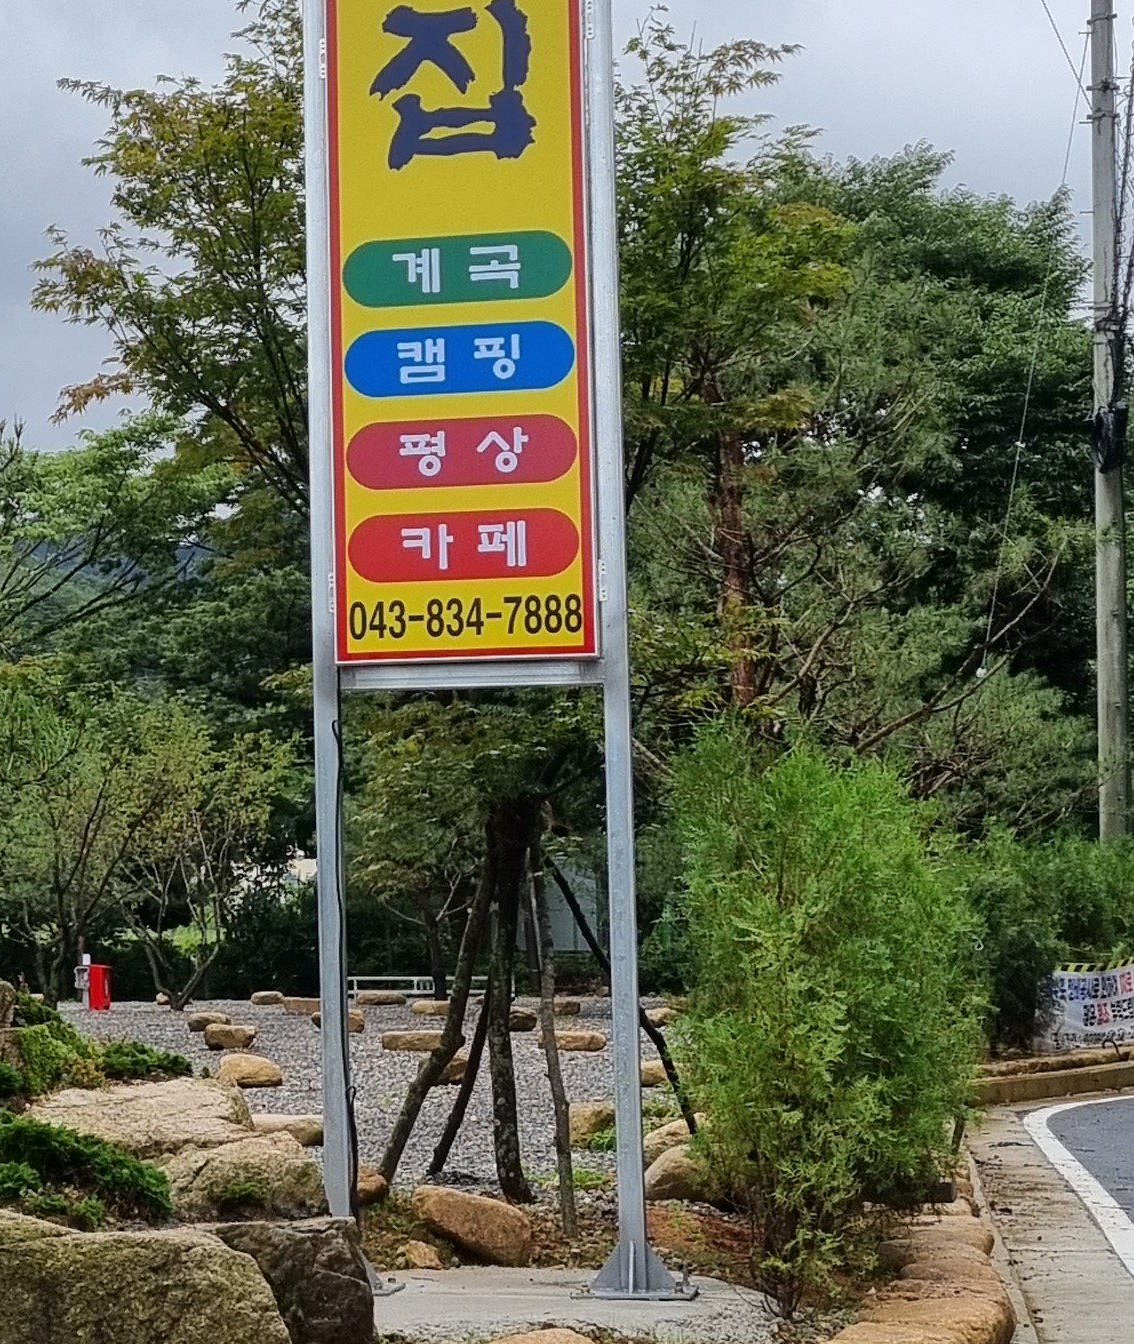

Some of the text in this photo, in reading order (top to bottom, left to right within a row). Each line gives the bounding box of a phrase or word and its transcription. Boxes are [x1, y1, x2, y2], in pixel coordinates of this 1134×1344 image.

[392, 244, 522, 294] 계곡
[397, 333, 521, 384] 캠핑
[399, 426, 529, 477] 평상
[401, 520, 527, 570] 카페
[349, 593, 583, 641] 043-834-7888
